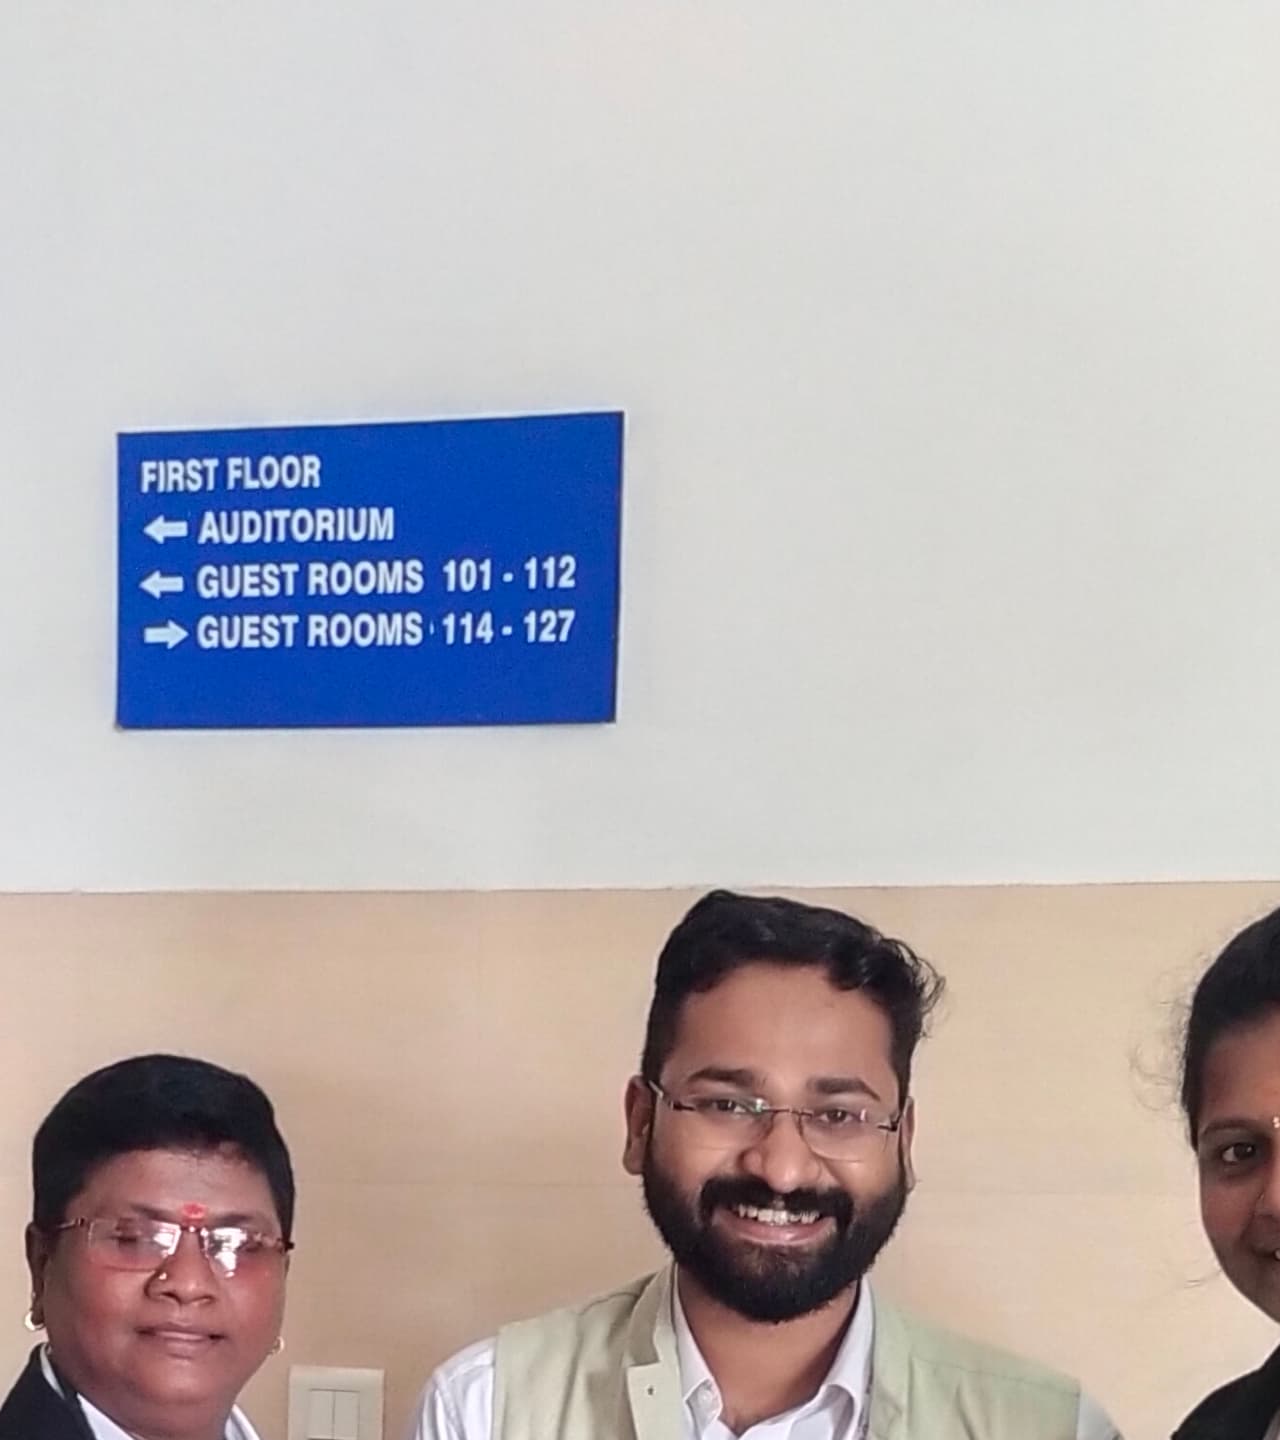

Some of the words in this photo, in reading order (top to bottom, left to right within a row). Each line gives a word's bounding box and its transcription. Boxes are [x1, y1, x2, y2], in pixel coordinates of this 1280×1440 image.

[141, 458, 218, 492] FIRST
[227, 455, 321, 489] FLOOR
[198, 507, 394, 544] AUDITORIUM
[197, 563, 298, 599] GUEST
[308, 560, 424, 595] ROOMS
[443, 558, 492, 592] 101
[525, 556, 576, 589] 112
[197, 615, 298, 648] GUEST
[308, 612, 422, 647] ROOMS
[443, 612, 493, 645] 114
[524, 610, 575, 643] 127
